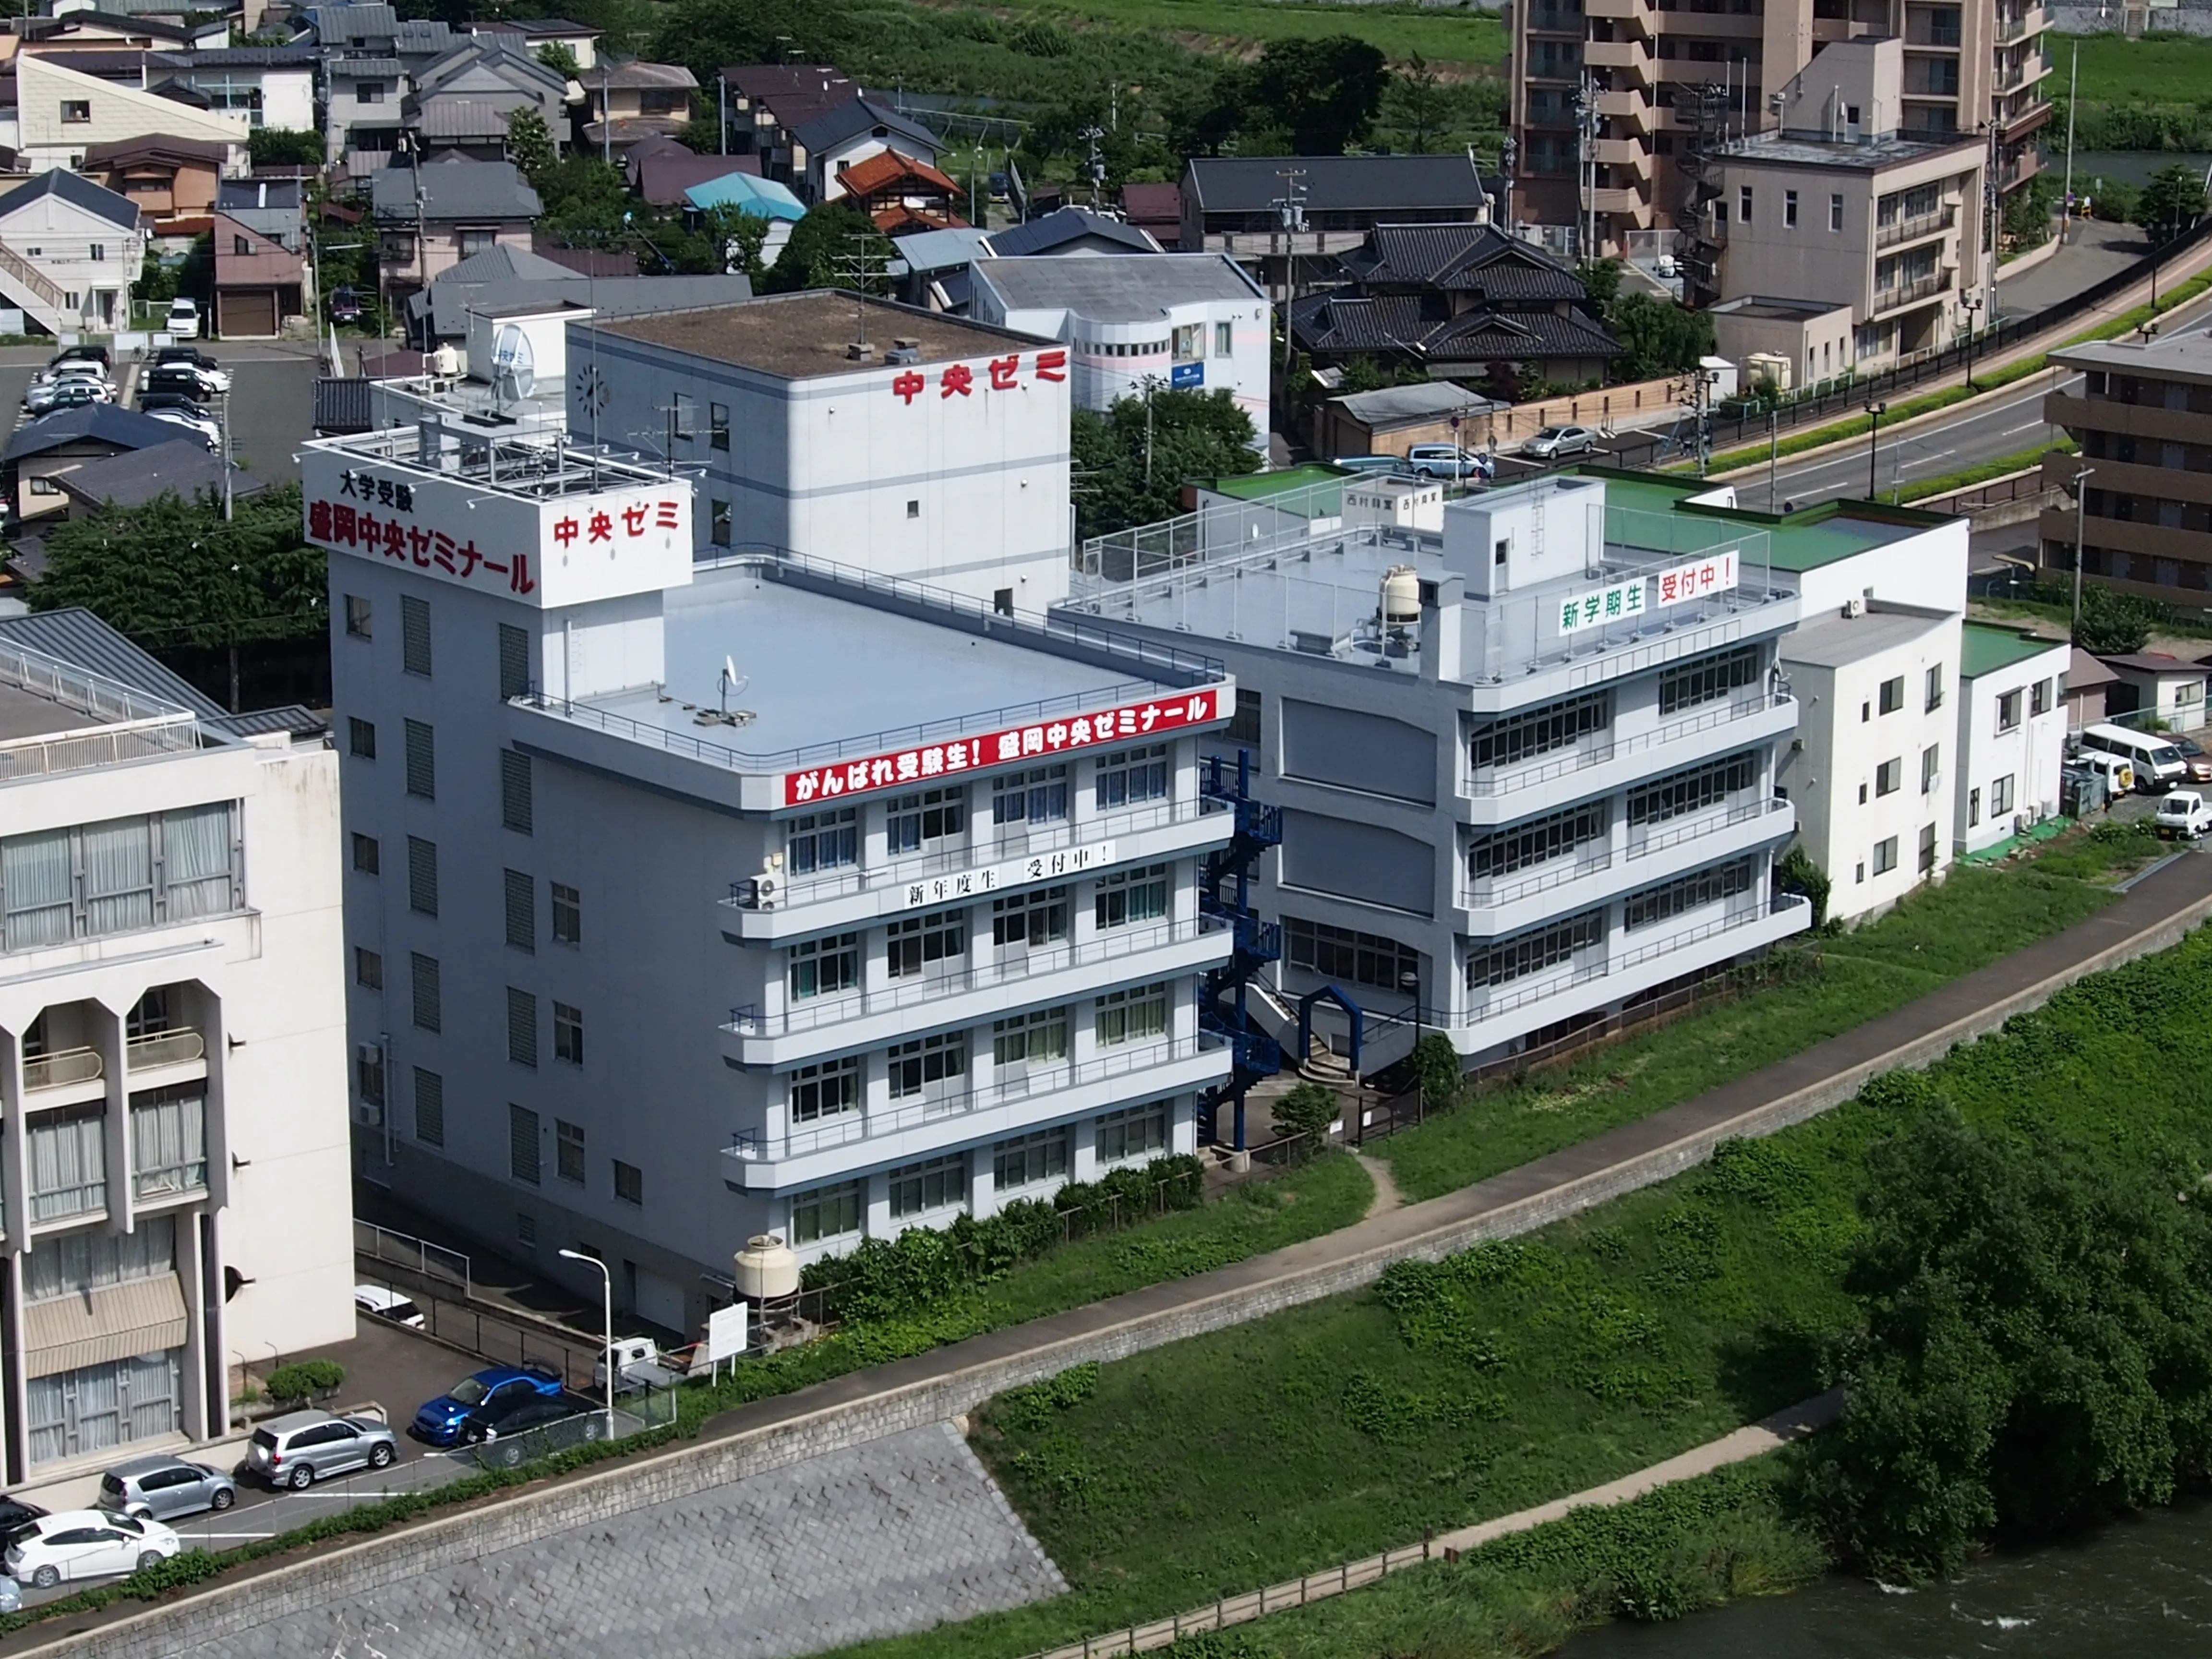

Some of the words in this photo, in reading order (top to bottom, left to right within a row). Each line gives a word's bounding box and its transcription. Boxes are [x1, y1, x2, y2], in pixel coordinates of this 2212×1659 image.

[893, 351, 1067, 405] 中央ゼミ
[340, 469, 413, 513] 大学受験
[309, 499, 535, 595] 盛岡中央ゼミナール
[554, 501, 679, 549] 中央ゼミ
[1563, 584, 1642, 630] 新学期生
[1661, 557, 1732, 602] 受付中！
[796, 739, 980, 800] がんばれ受験生！
[998, 697, 1207, 759] 盛岡中央ゼミナール
[909, 870, 996, 905] 新年度生
[1027, 846, 1106, 879] 受付中！
